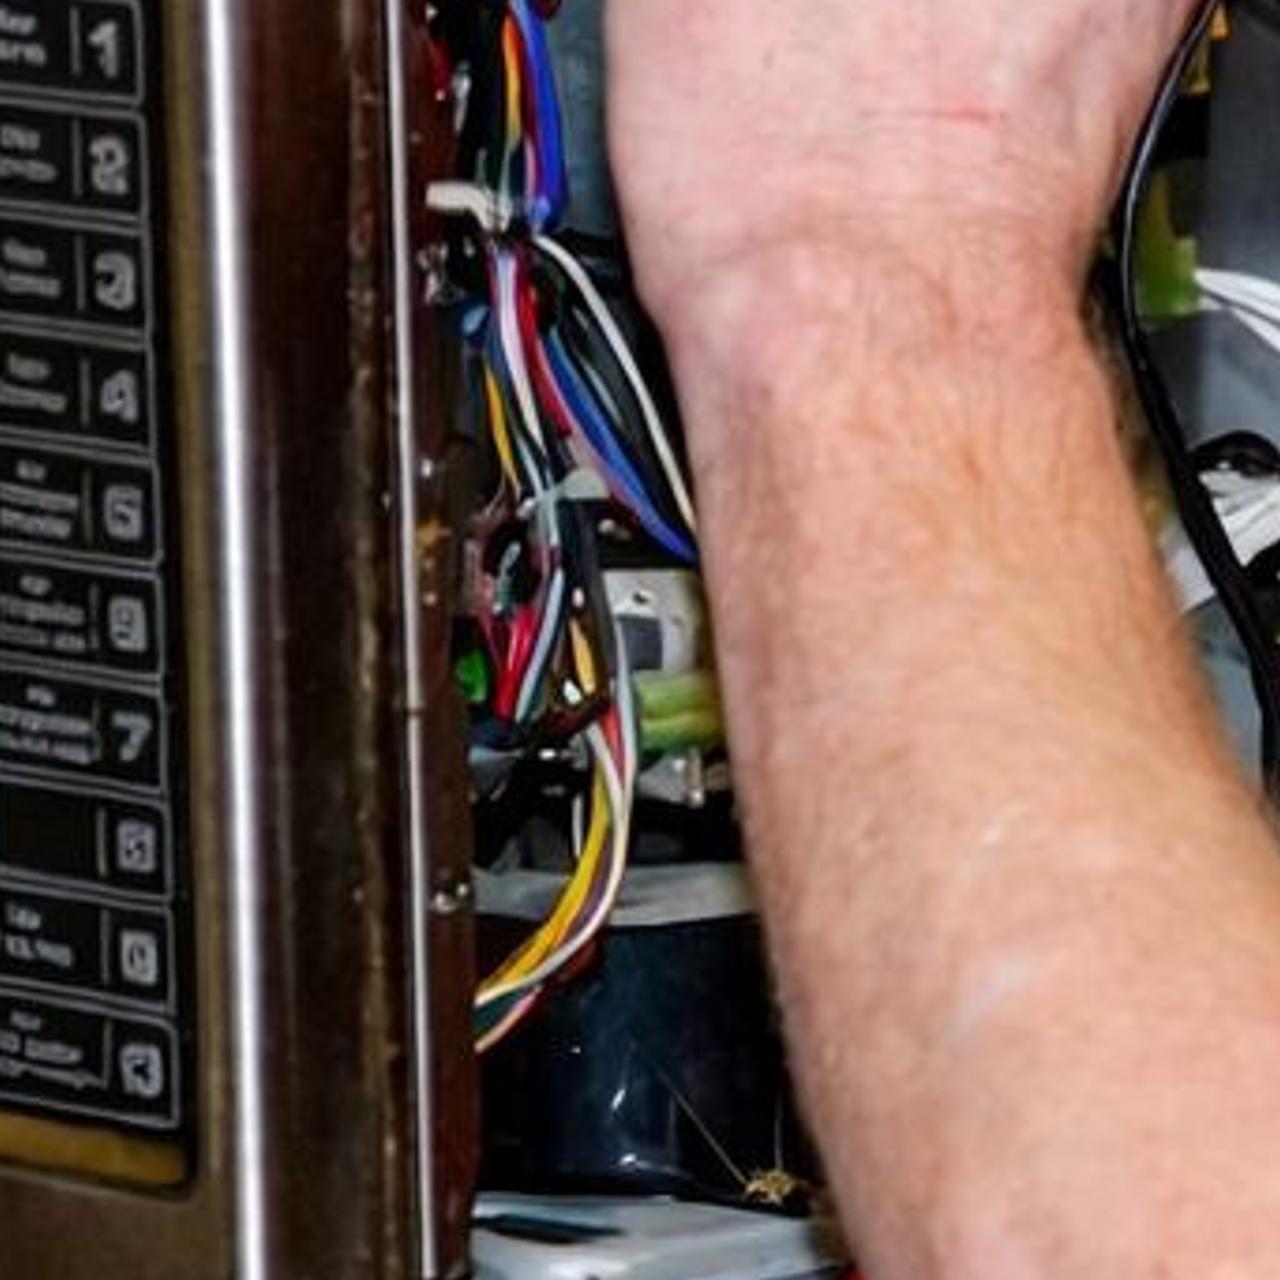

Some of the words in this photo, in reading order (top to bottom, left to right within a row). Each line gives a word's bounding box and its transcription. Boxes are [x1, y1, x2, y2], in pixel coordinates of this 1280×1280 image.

[88, 20, 118, 79] 1
[89, 136, 128, 195] 2
[93, 251, 135, 310] 3
[99, 369, 139, 424] 4
[111, 712, 153, 761] 7
